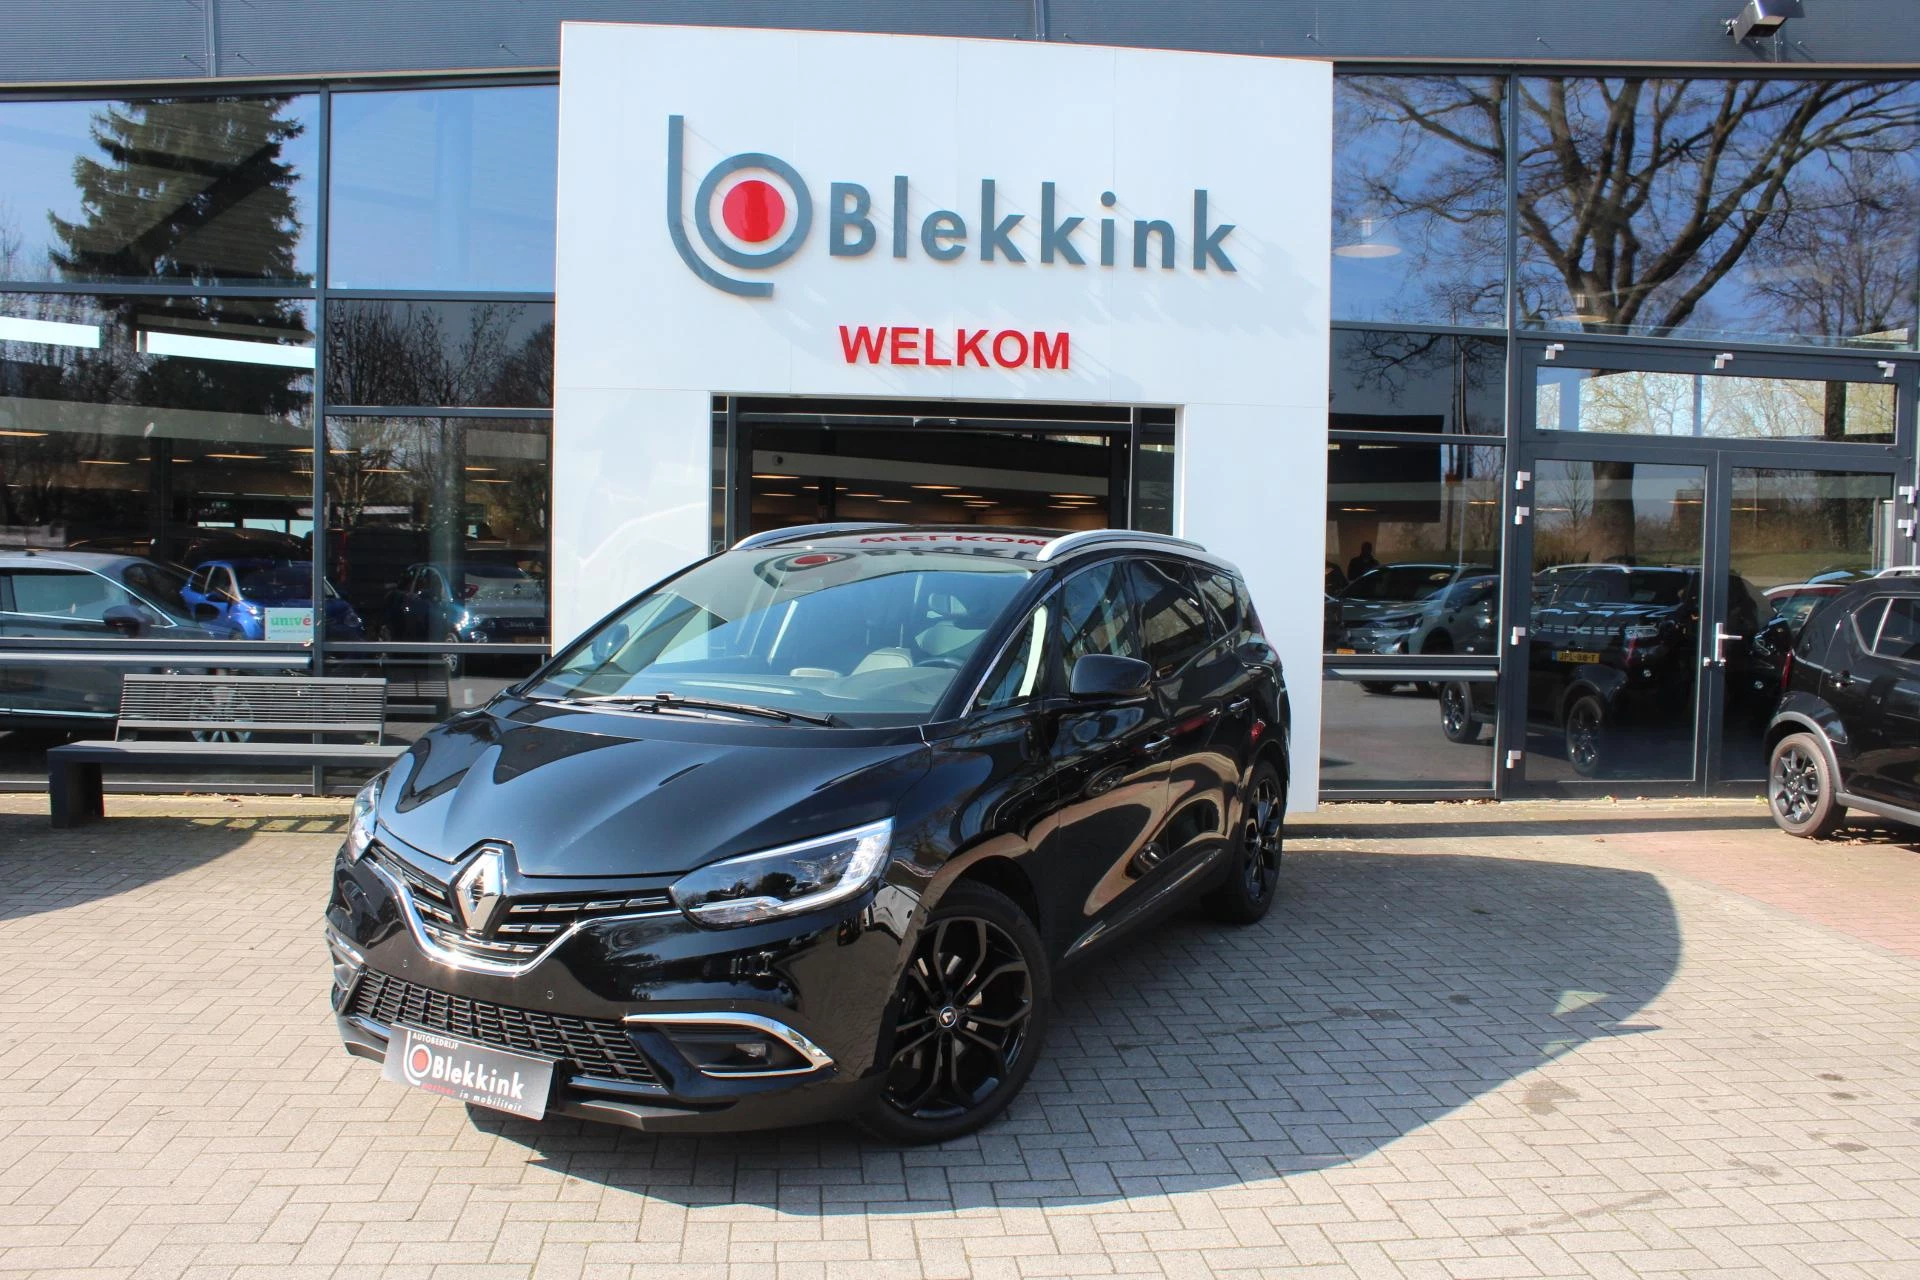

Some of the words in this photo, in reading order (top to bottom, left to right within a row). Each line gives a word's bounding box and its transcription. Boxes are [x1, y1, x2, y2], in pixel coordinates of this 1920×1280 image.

[828, 175, 1237, 272] Blekkink
[839, 325, 1070, 369] WELKOM
[412, 1032, 459, 1050] AUTOBEDRIJF
[432, 1055, 525, 1100] Blekkink
[459, 1089, 469, 1099] in
[473, 1094, 523, 1112] mobiliteit
